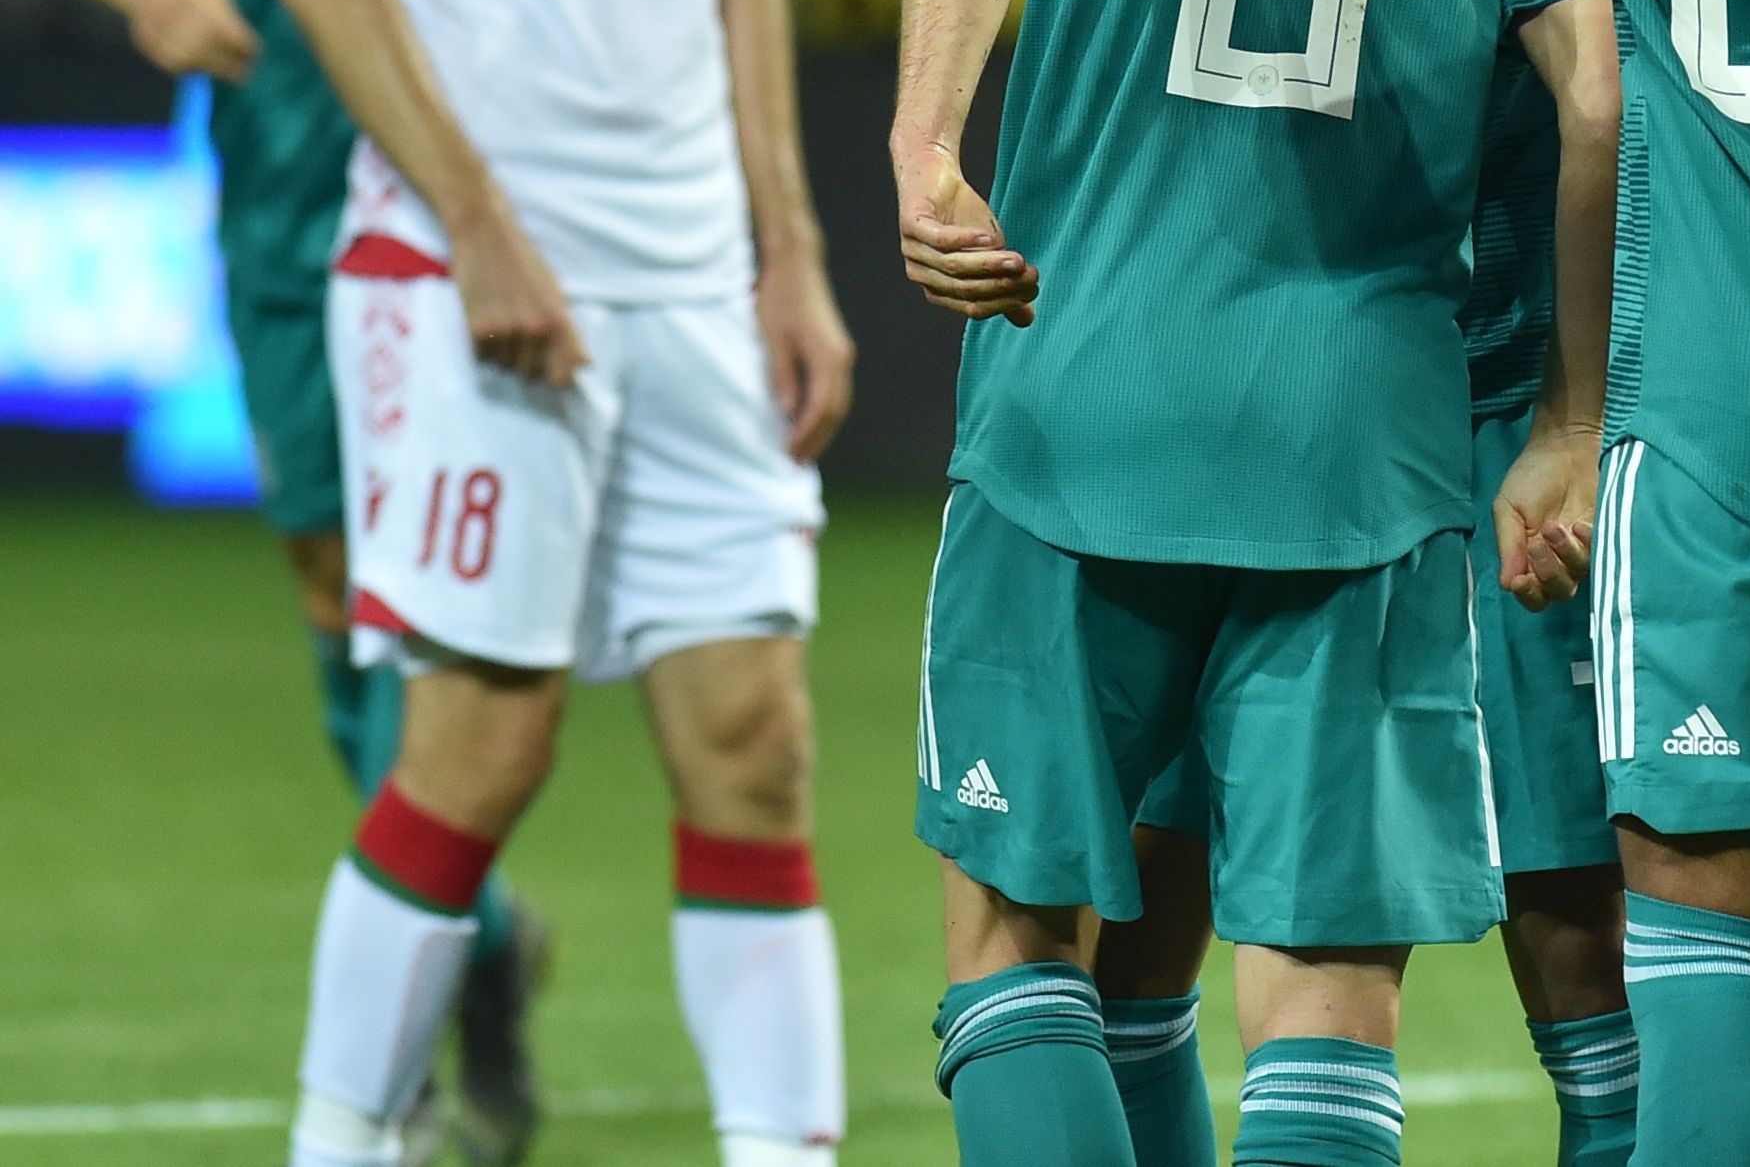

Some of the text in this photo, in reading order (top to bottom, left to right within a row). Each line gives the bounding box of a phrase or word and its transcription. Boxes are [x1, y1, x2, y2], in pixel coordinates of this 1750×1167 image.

[419, 469, 501, 581] 18
[1662, 735, 1741, 756] adidas
[957, 787, 1009, 813] adidas
